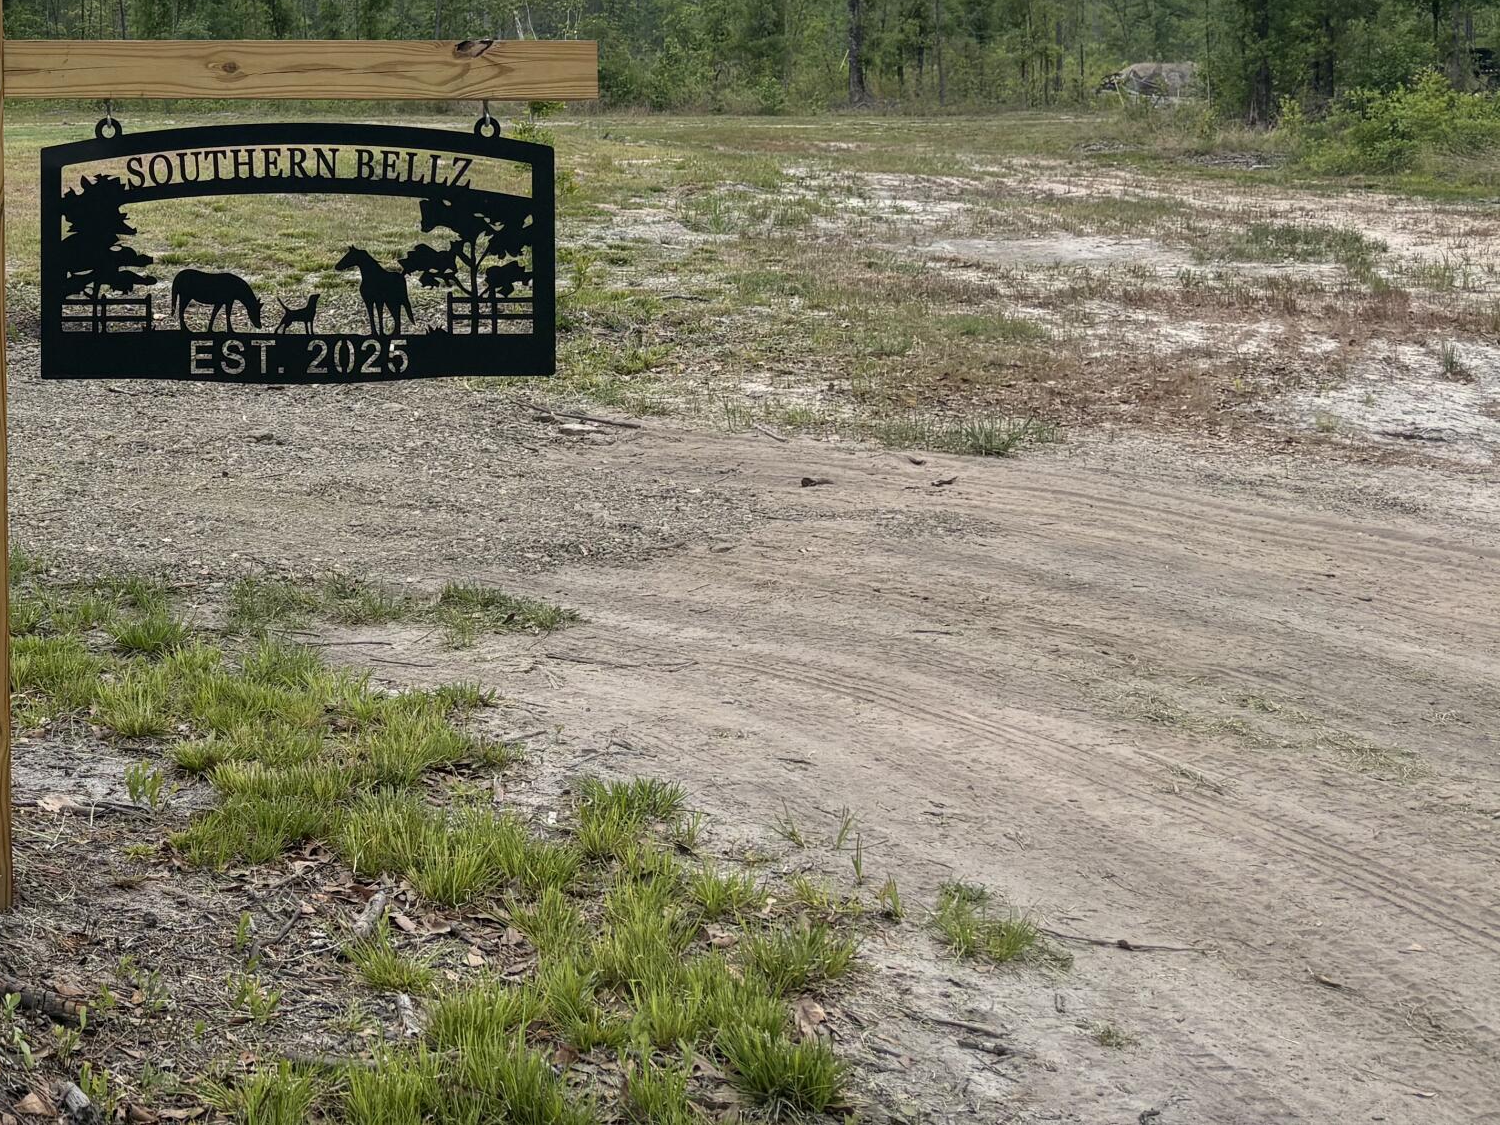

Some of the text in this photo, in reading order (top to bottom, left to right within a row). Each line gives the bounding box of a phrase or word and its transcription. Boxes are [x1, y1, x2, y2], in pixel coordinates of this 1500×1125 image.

[126, 148, 473, 190] SOUTHERN BELLZ
[190, 339, 409, 374] EST. 2025
